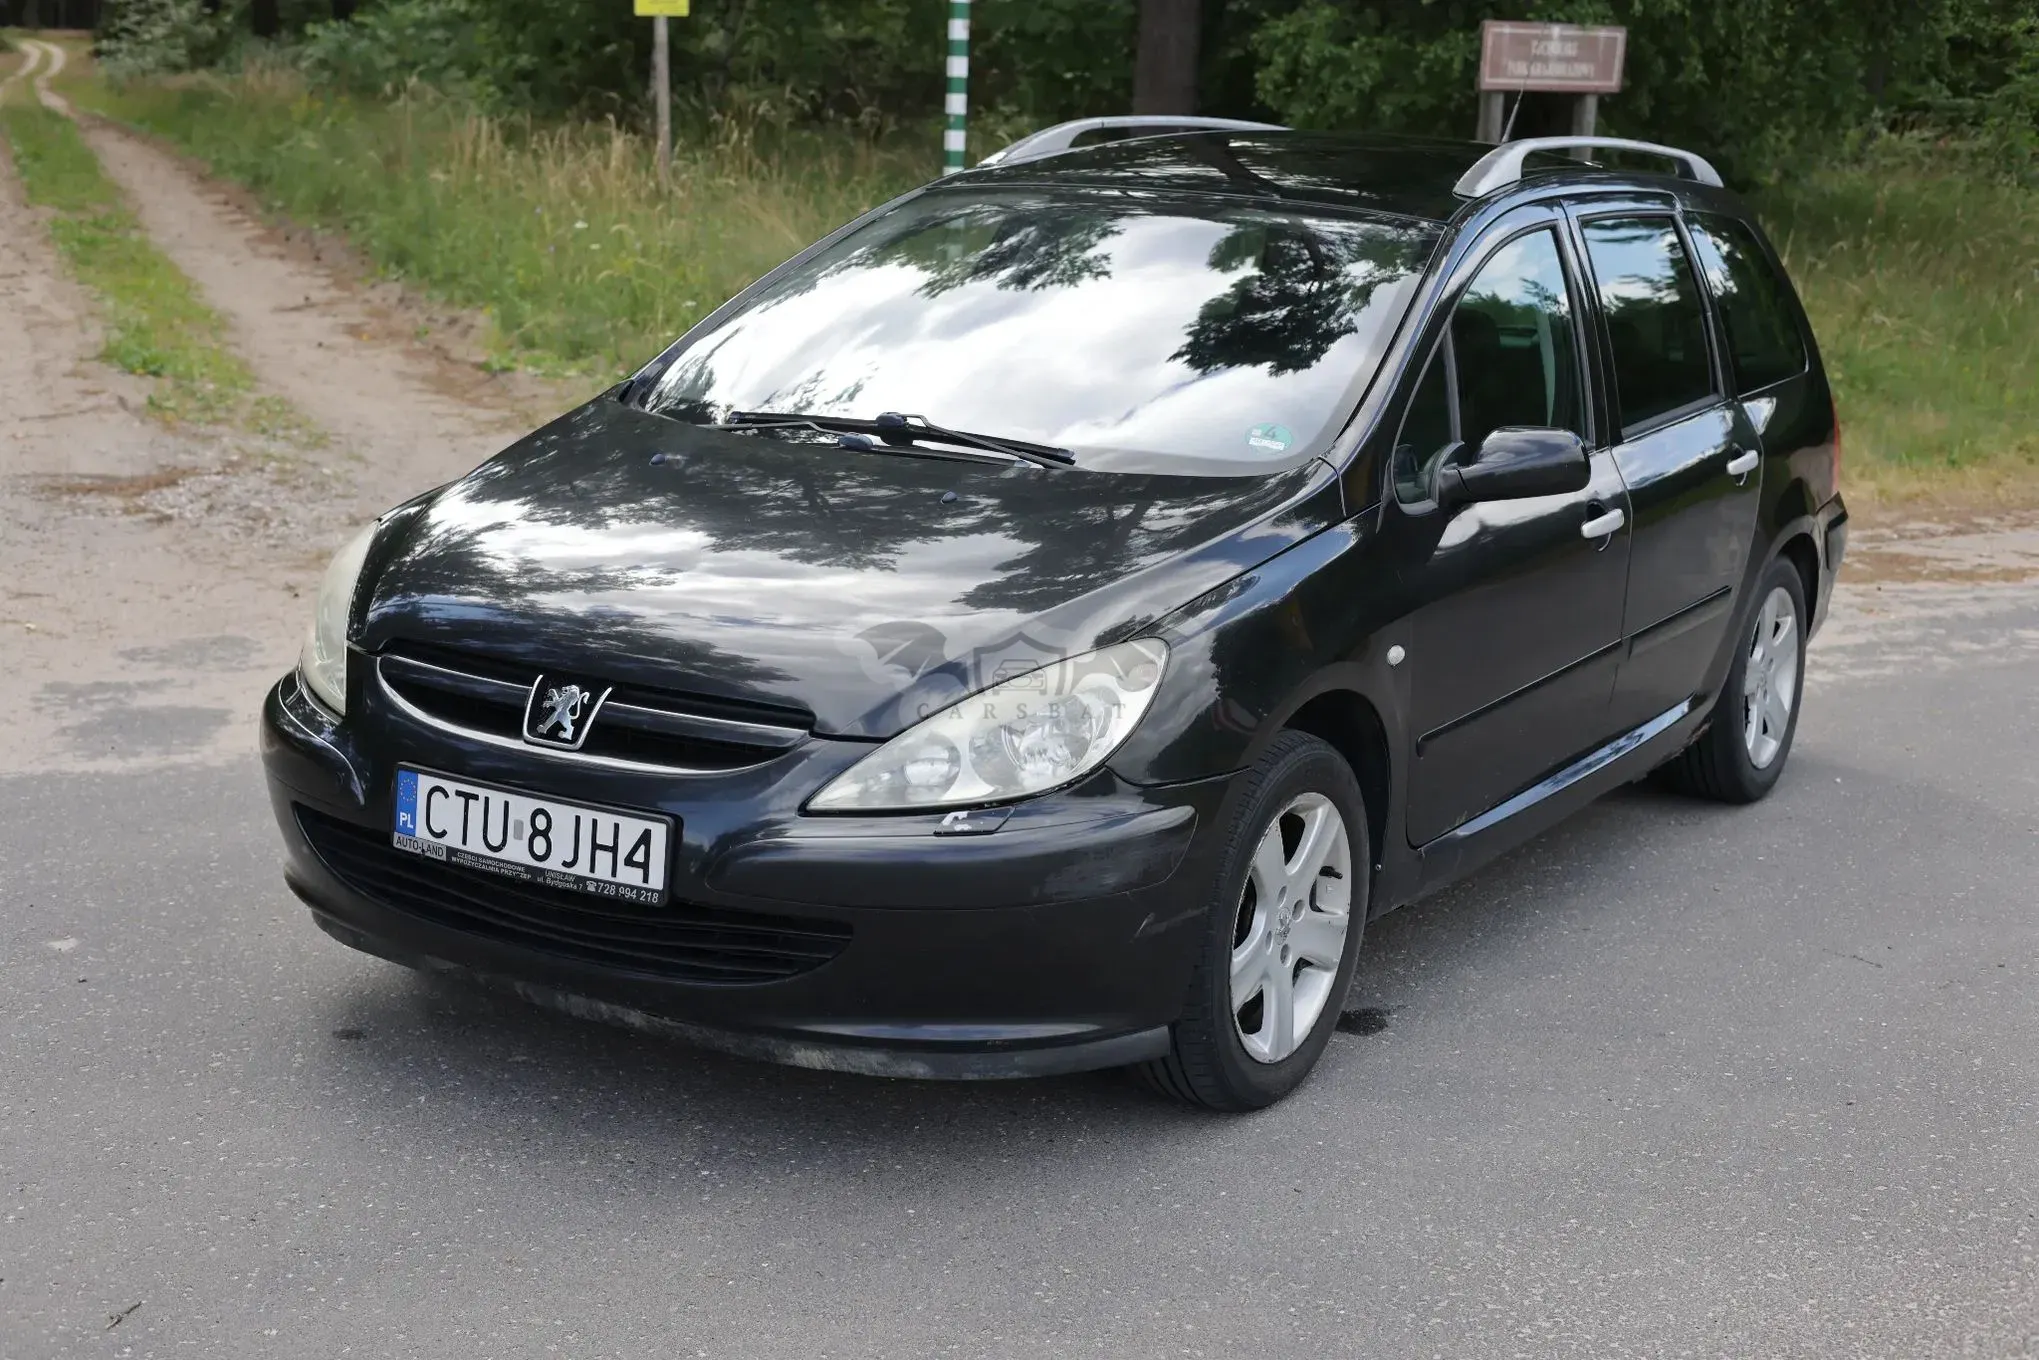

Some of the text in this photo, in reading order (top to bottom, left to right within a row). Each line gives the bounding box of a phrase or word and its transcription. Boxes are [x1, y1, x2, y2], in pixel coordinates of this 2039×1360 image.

[399, 811, 414, 829] PL
[425, 785, 652, 884] CTU 8JH4
[395, 836, 444, 857] AUTO-LAND
[597, 882, 659, 903] 728 994 218
